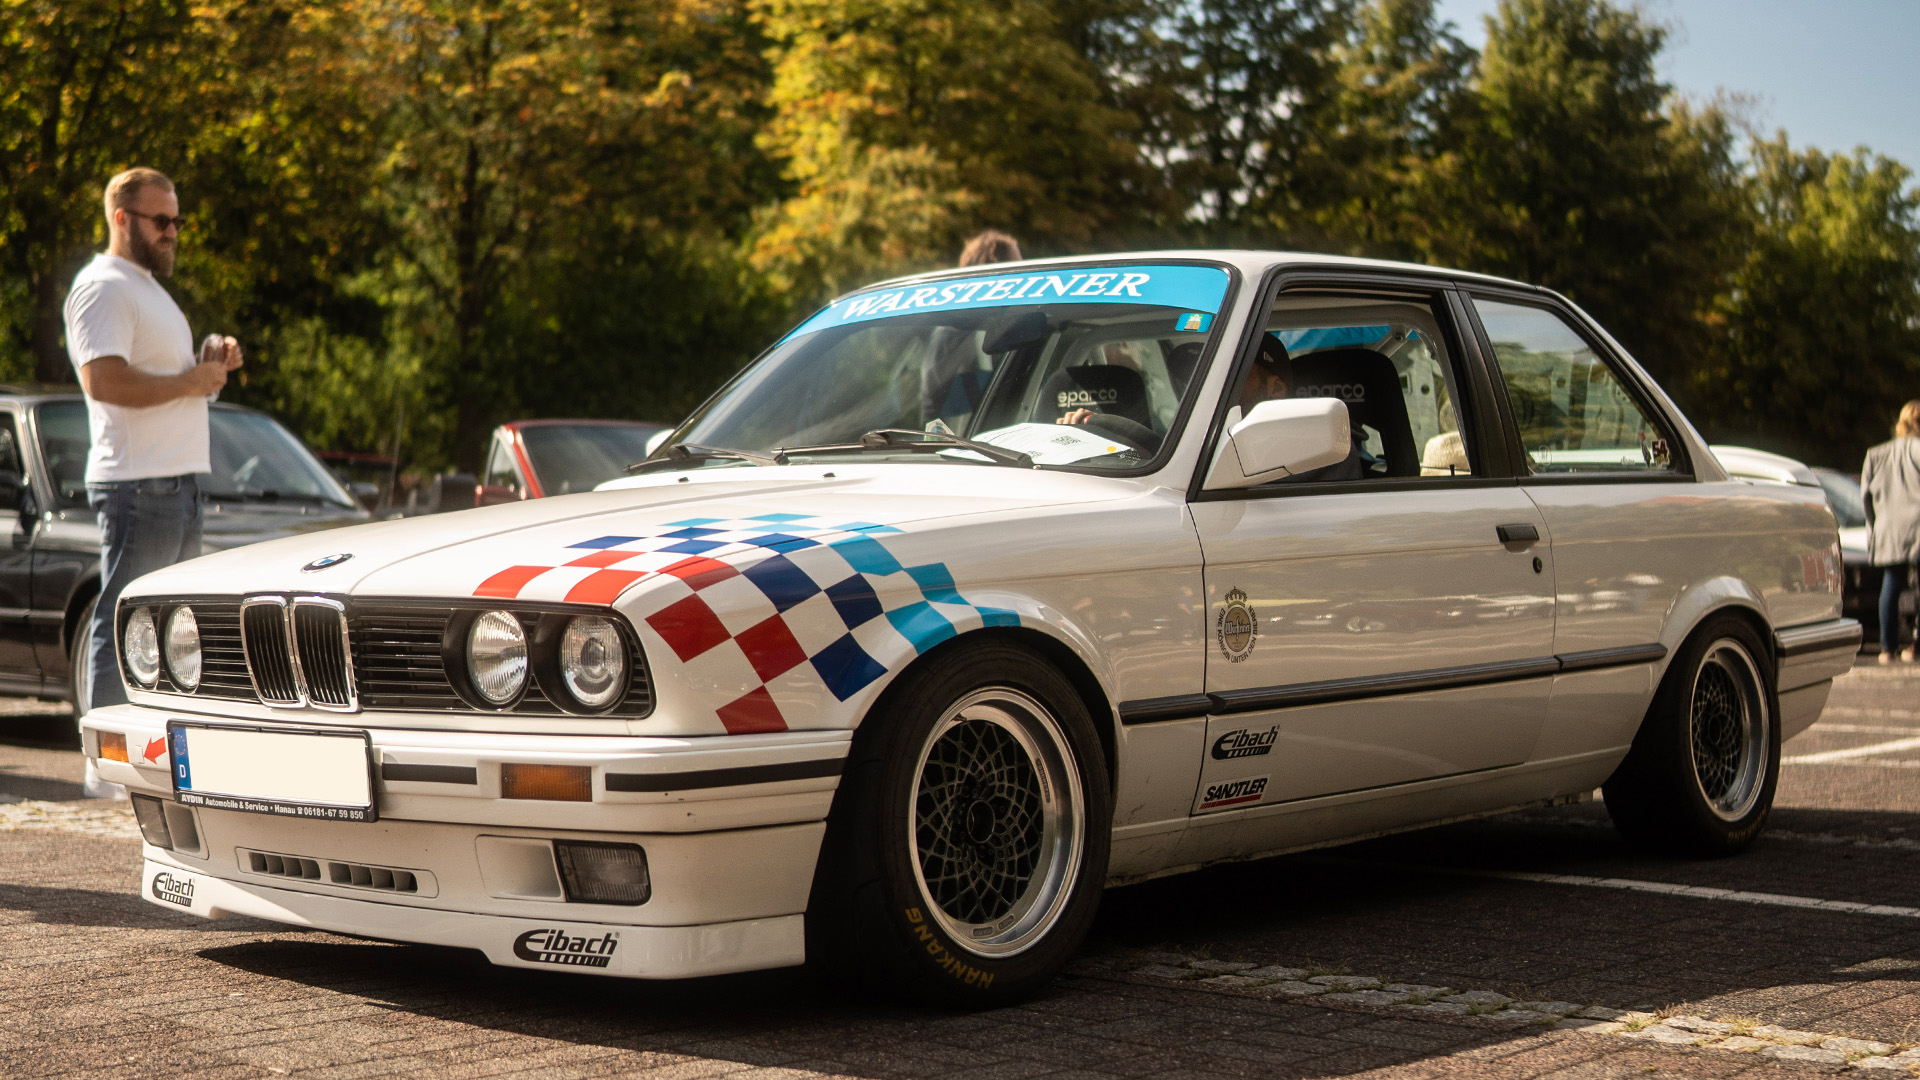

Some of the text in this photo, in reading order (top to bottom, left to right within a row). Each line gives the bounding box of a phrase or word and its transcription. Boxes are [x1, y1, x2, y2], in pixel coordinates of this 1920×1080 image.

[842, 273, 1151, 319] WARSTEINER
[1057, 388, 1118, 408] sparco
[1230, 652, 1249, 664] UNTER
[1247, 636, 1257, 654] DEN
[1211, 726, 1279, 760] Eibach
[179, 763, 187, 779] D
[1203, 778, 1268, 802] SANDTLER
[205, 797, 239, 809] Automobile
[239, 801, 245, 809] &
[245, 801, 269, 812] Service
[274, 804, 296, 815] Hanau
[303, 806, 337, 818] 06181-67
[338, 808, 349, 818] 59
[349, 810, 364, 820] 850
[152, 872, 195, 900] Eibach
[513, 929, 618, 963] Eibach
[905, 907, 995, 989] NANKANG
